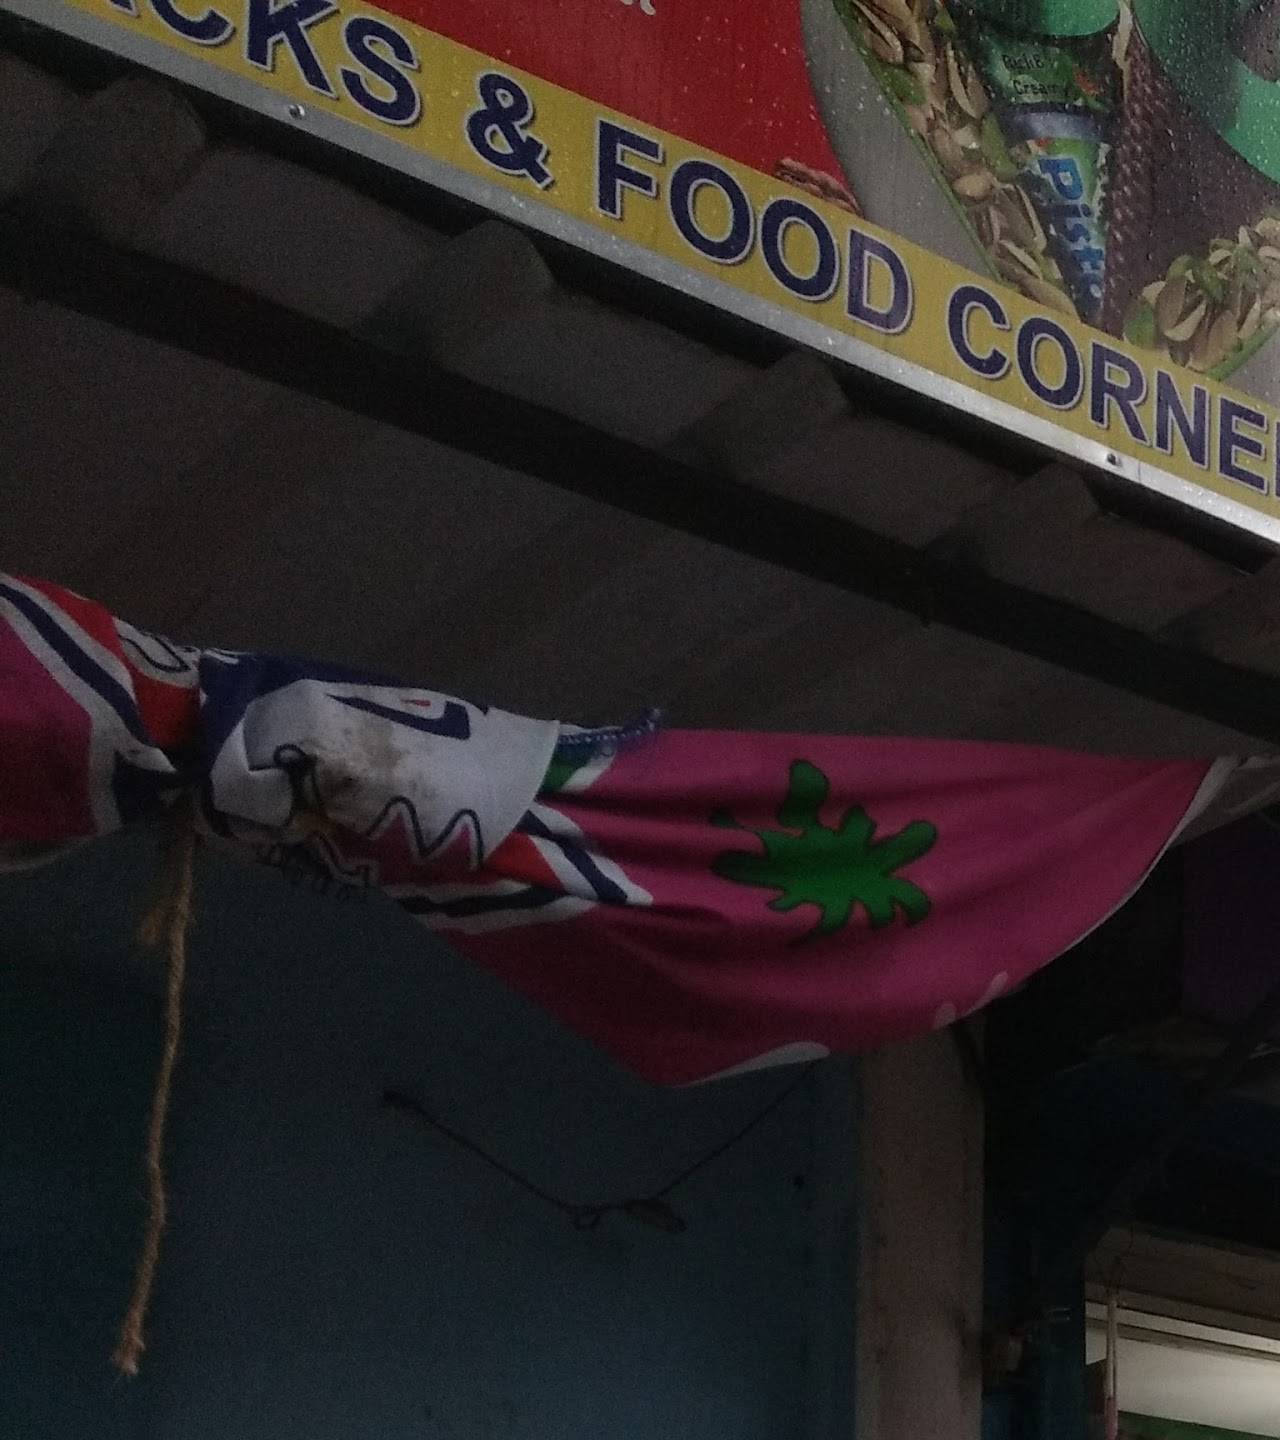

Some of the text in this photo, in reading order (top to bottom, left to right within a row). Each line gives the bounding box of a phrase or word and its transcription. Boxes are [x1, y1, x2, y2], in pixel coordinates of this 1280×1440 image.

[102, 0, 424, 128] CKS
[466, 73, 557, 190] &
[595, 118, 914, 335] FOOD
